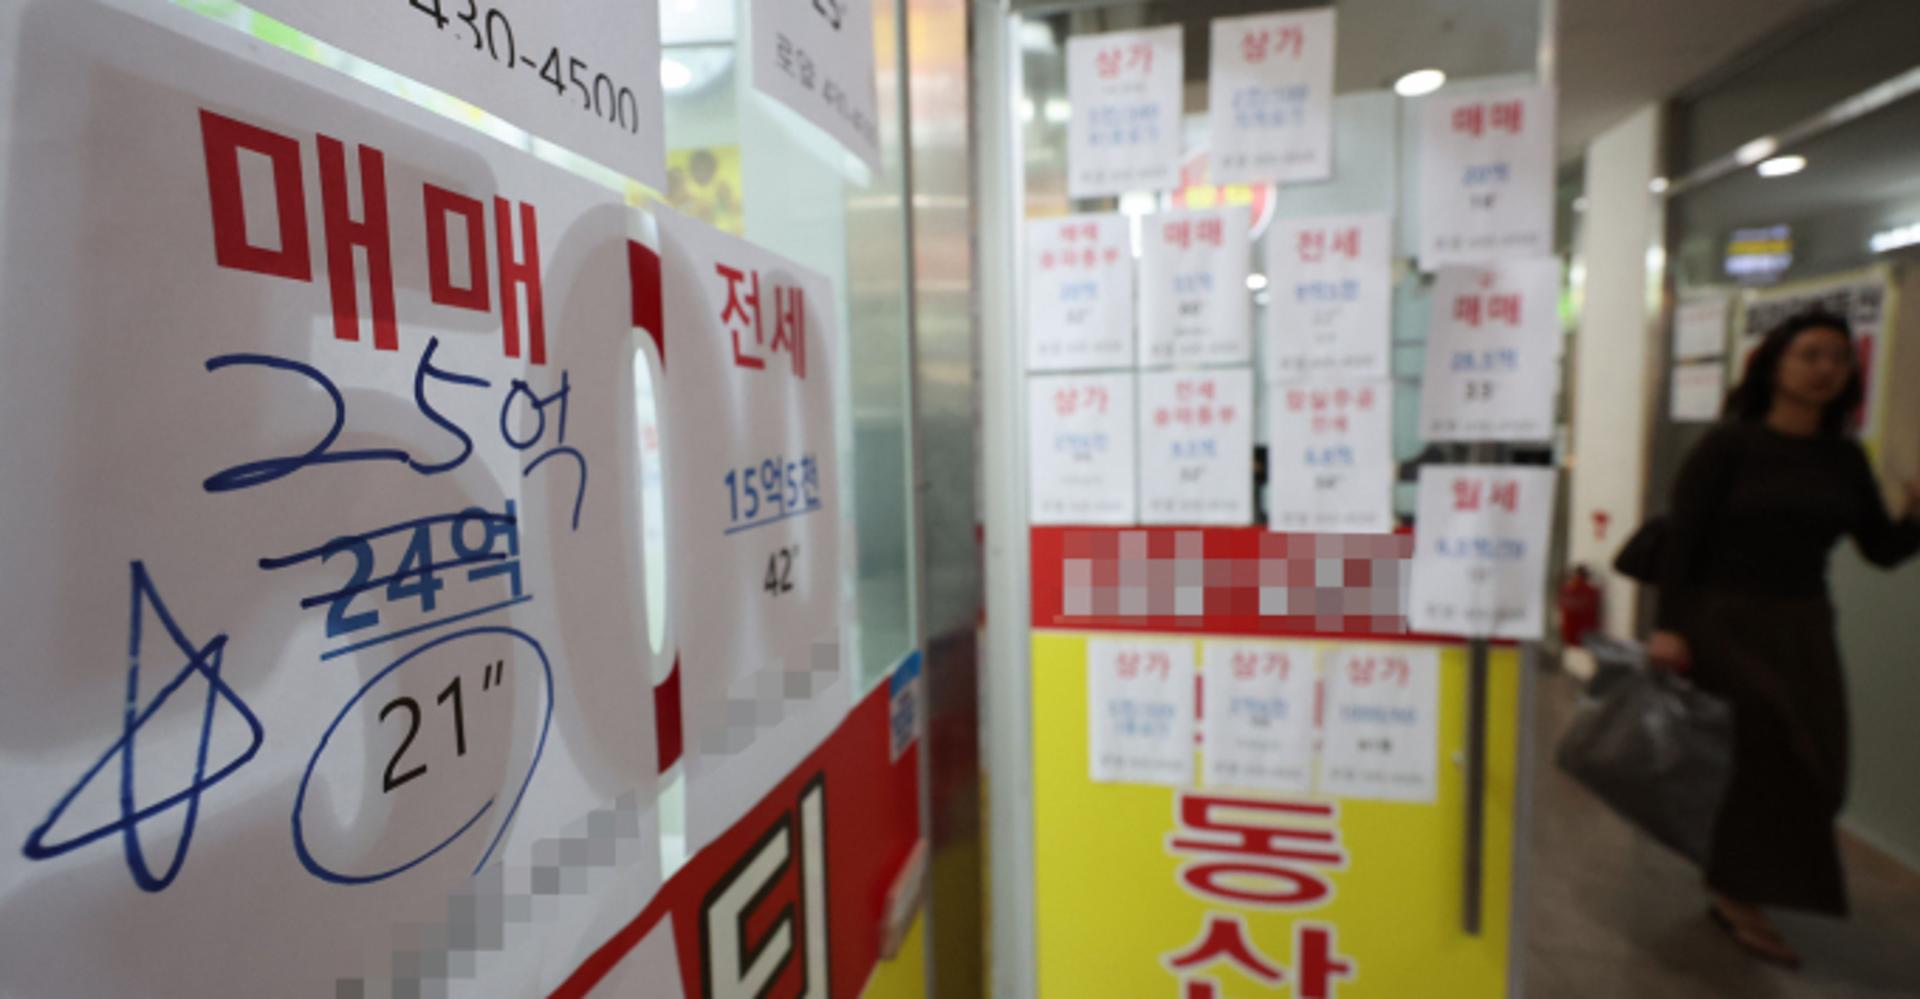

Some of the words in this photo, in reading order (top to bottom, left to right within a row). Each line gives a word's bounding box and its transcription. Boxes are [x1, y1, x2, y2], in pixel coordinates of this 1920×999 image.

[1096, 42, 1154, 79] 상가
[1241, 26, 1304, 64] 상가
[1452, 101, 1525, 140] 매매
[198, 108, 546, 366] 매매
[1163, 219, 1225, 249] 매매
[1296, 228, 1362, 265] 전세
[715, 262, 806, 379] 전세
[1453, 293, 1525, 329] 매매
[1055, 386, 1109, 416] 상가
[203, 337, 588, 530] 25억
[724, 455, 820, 522] 15억5천
[1451, 477, 1521, 515] 월세
[322, 499, 523, 638] 24억
[1115, 650, 1171, 683] 상가
[1231, 650, 1290, 682] 상가
[1345, 656, 1410, 689] 상가
